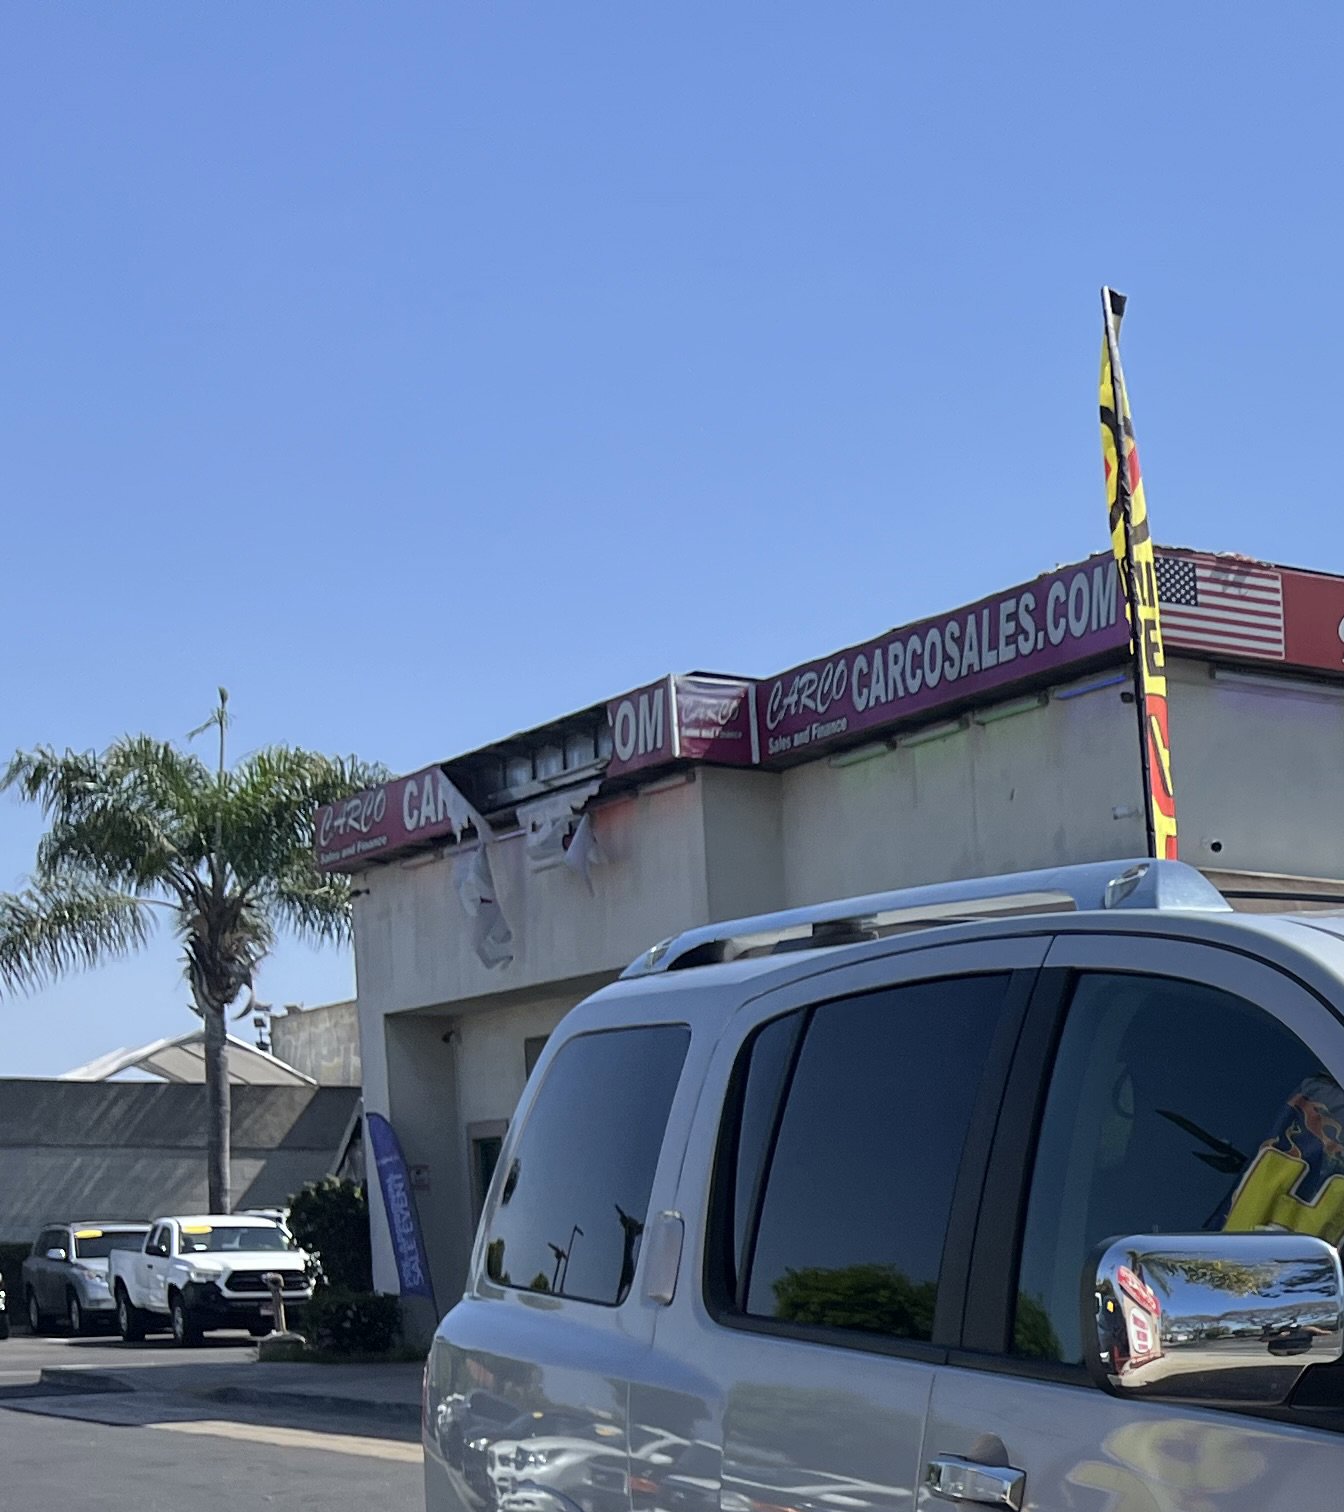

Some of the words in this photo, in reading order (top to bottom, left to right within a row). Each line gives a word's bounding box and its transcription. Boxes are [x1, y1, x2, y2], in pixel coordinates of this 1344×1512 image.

[766, 659, 848, 731] CARCO
[851, 561, 1118, 713] CARCOSALES.COM
[607, 688, 665, 762] OM
[768, 732, 791, 756] Sales
[793, 724, 810, 748] and
[811, 716, 848, 741] Finance
[319, 788, 386, 847] CARCO
